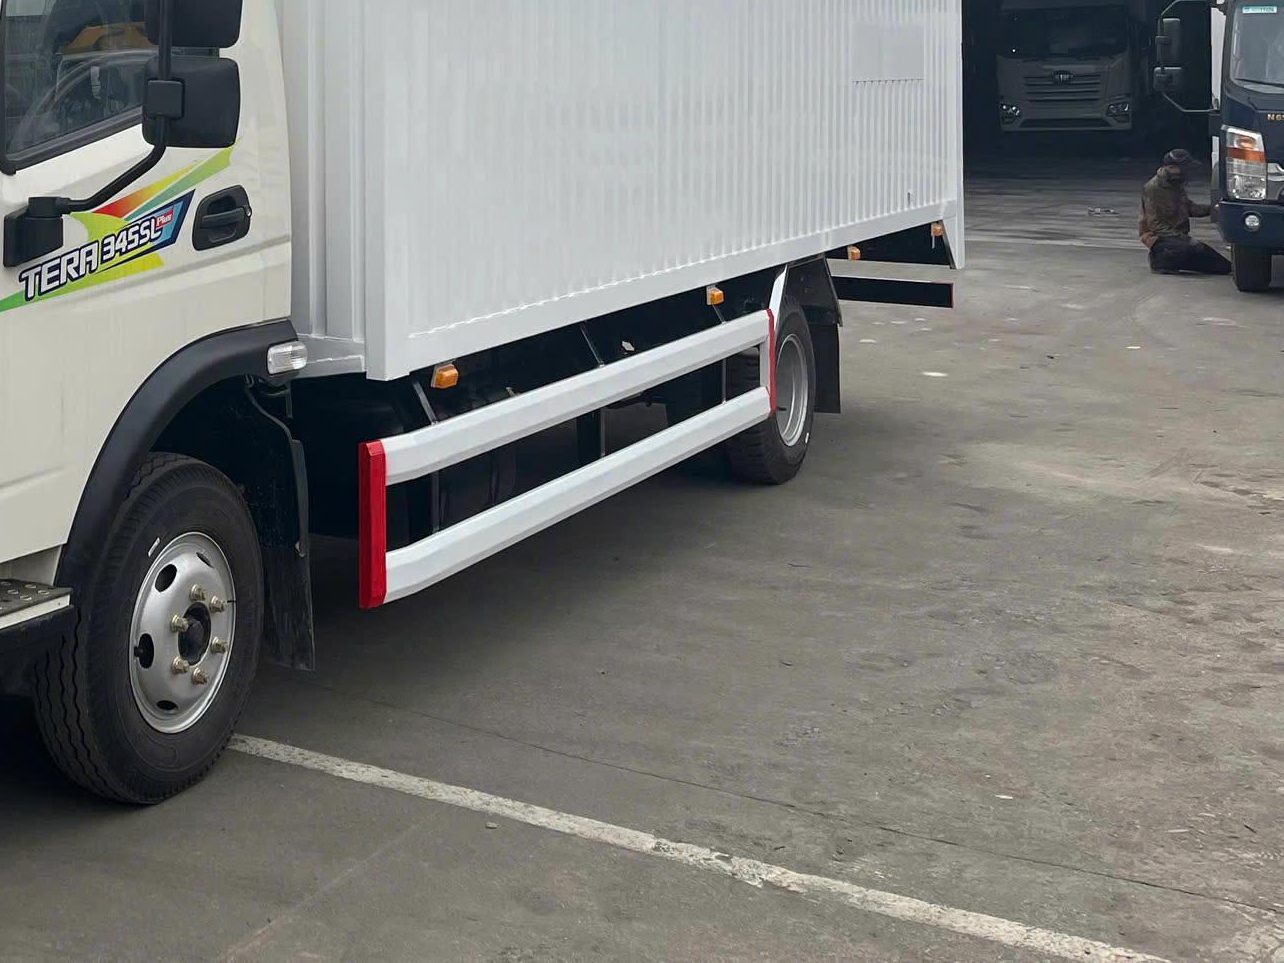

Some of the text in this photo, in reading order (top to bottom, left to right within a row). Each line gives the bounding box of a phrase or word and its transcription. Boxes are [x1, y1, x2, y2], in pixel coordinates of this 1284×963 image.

[19, 213, 172, 301] TERA 345SL Plus
